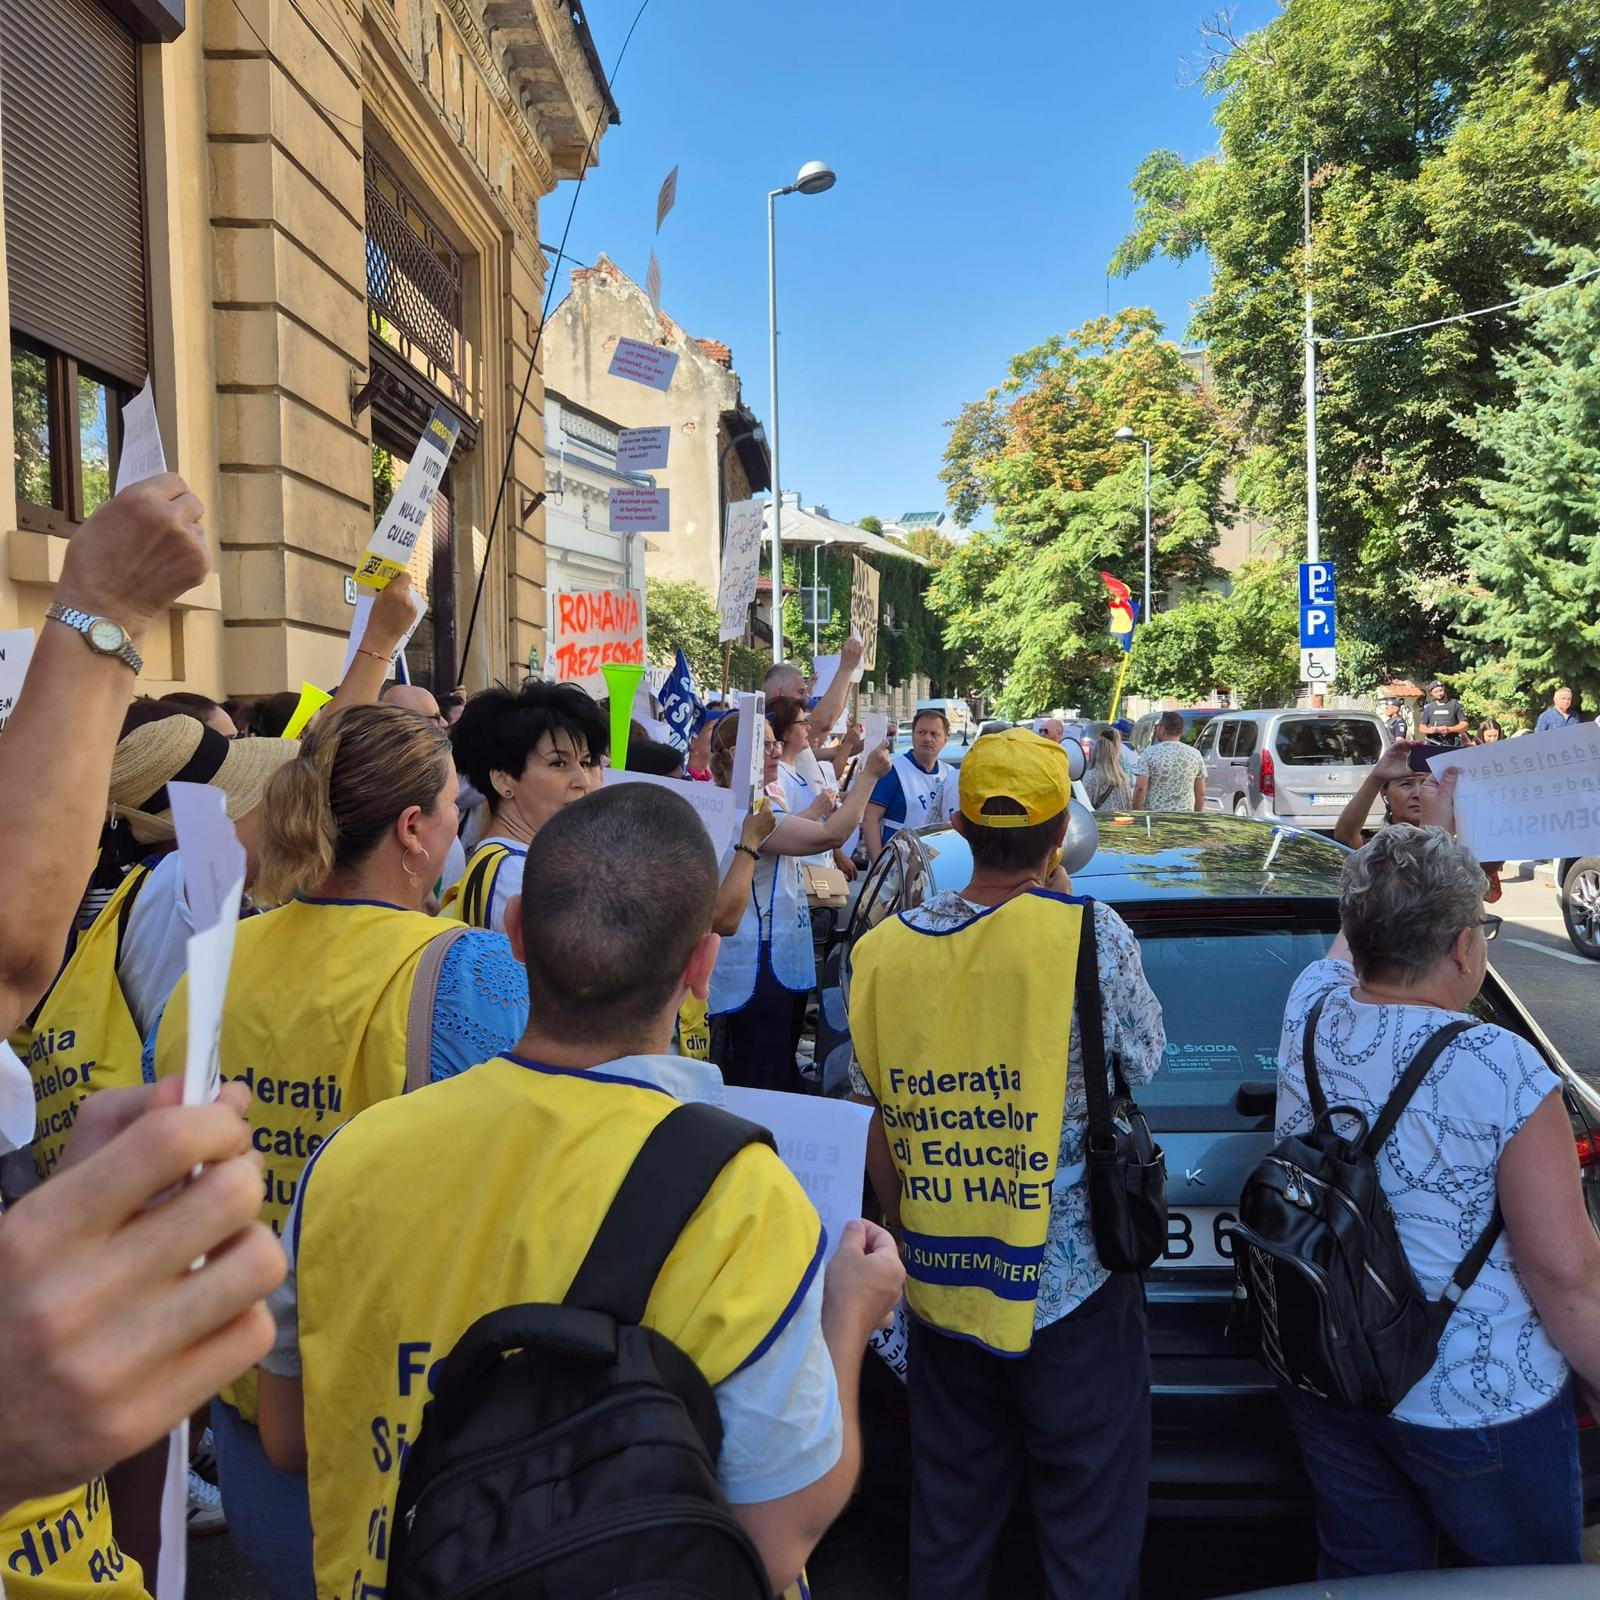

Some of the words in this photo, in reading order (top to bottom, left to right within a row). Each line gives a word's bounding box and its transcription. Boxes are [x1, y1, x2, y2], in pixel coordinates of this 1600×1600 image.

[387, 525, 399, 541] CU
[1308, 565, 1327, 600] P
[1307, 609, 1326, 636] P
[686, 1034, 707, 1050] din
[1183, 1043, 1238, 1053] ŠKODA
[889, 1063, 1021, 1100] Federația
[882, 1102, 1039, 1132] Sindicatelor
[921, 1141, 1049, 1178] Educație
[1163, 1212, 1195, 1260] B
[914, 1248, 991, 1270] SUNTEM
[8, 1508, 85, 1577] din
